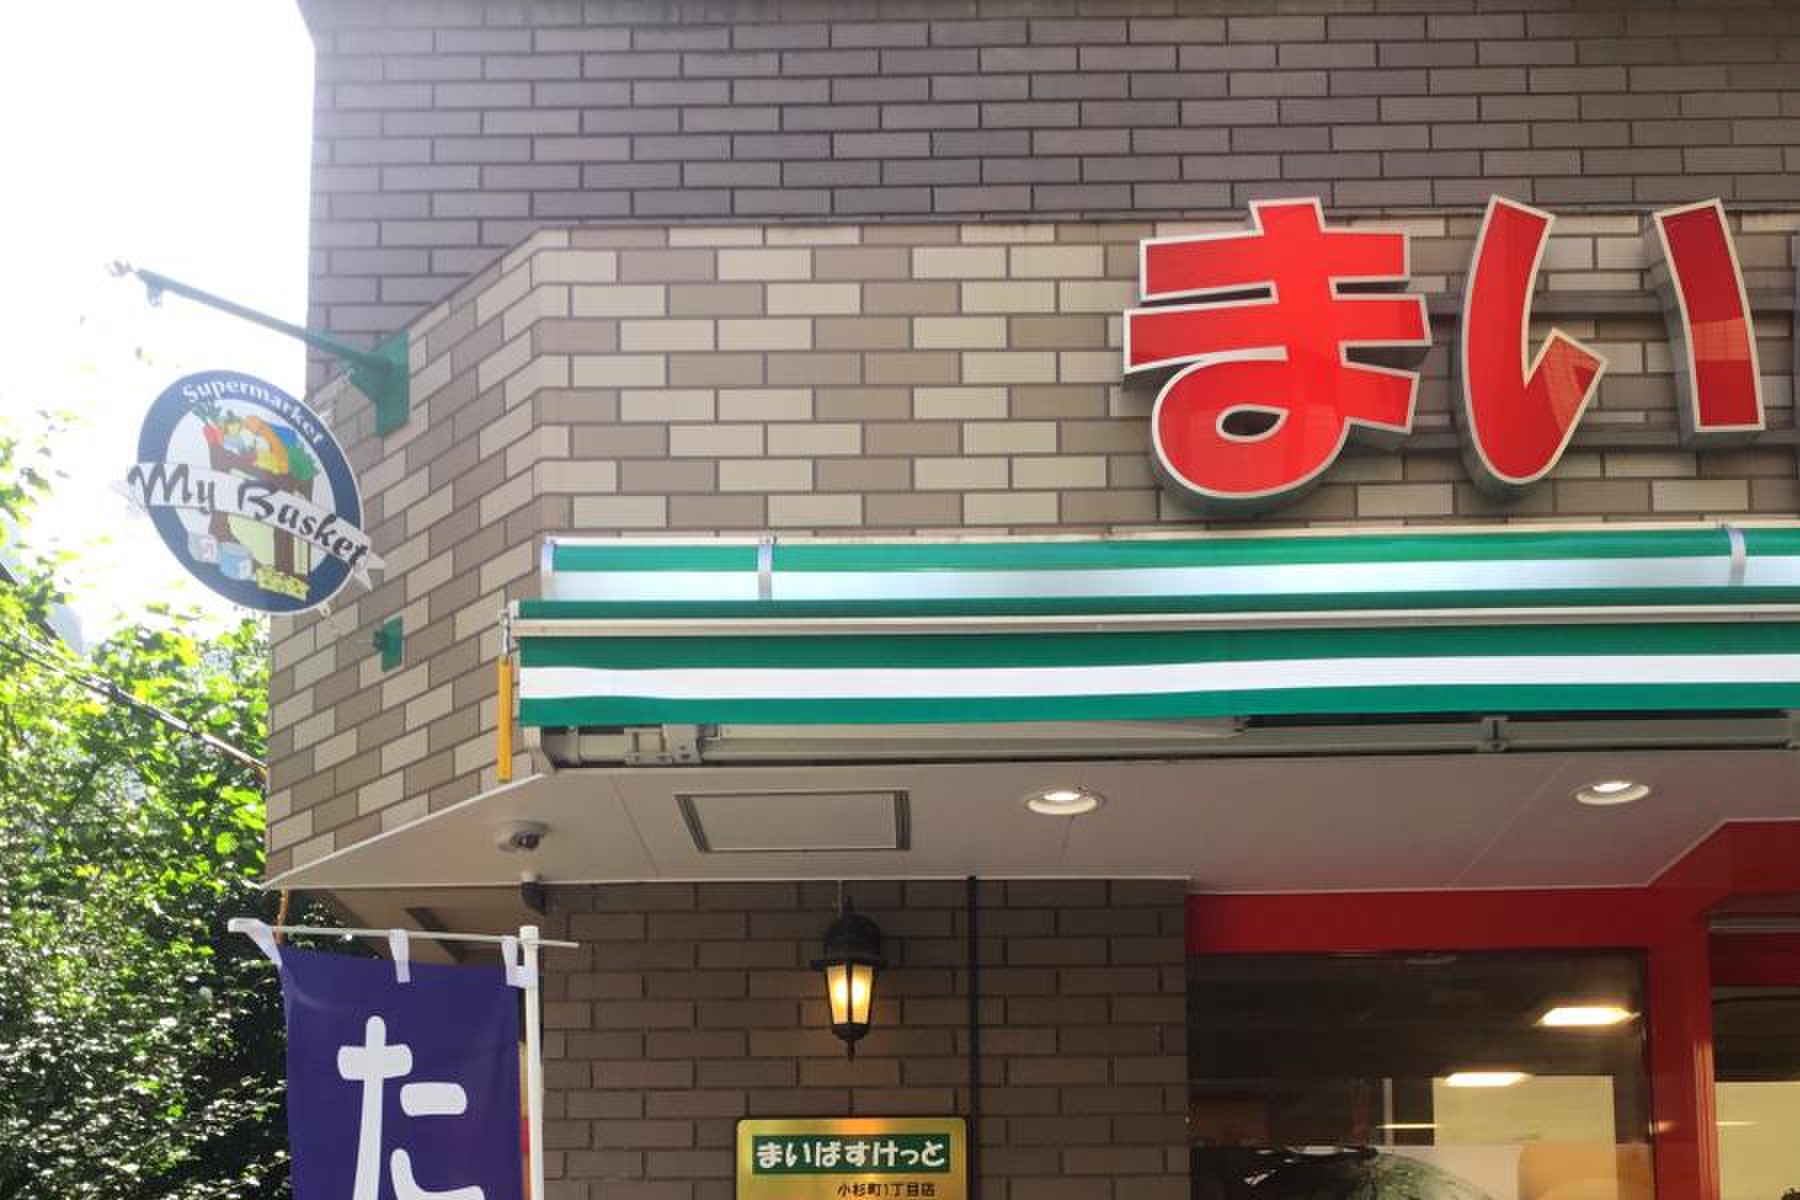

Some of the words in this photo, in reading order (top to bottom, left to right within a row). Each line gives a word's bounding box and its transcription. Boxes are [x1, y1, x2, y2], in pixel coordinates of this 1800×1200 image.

[1122, 194, 1766, 500] まい
[182, 380, 324, 444] Supermarket
[127, 463, 216, 515] My
[237, 481, 369, 566] Basket
[756, 1140, 946, 1168] まいばすけっと
